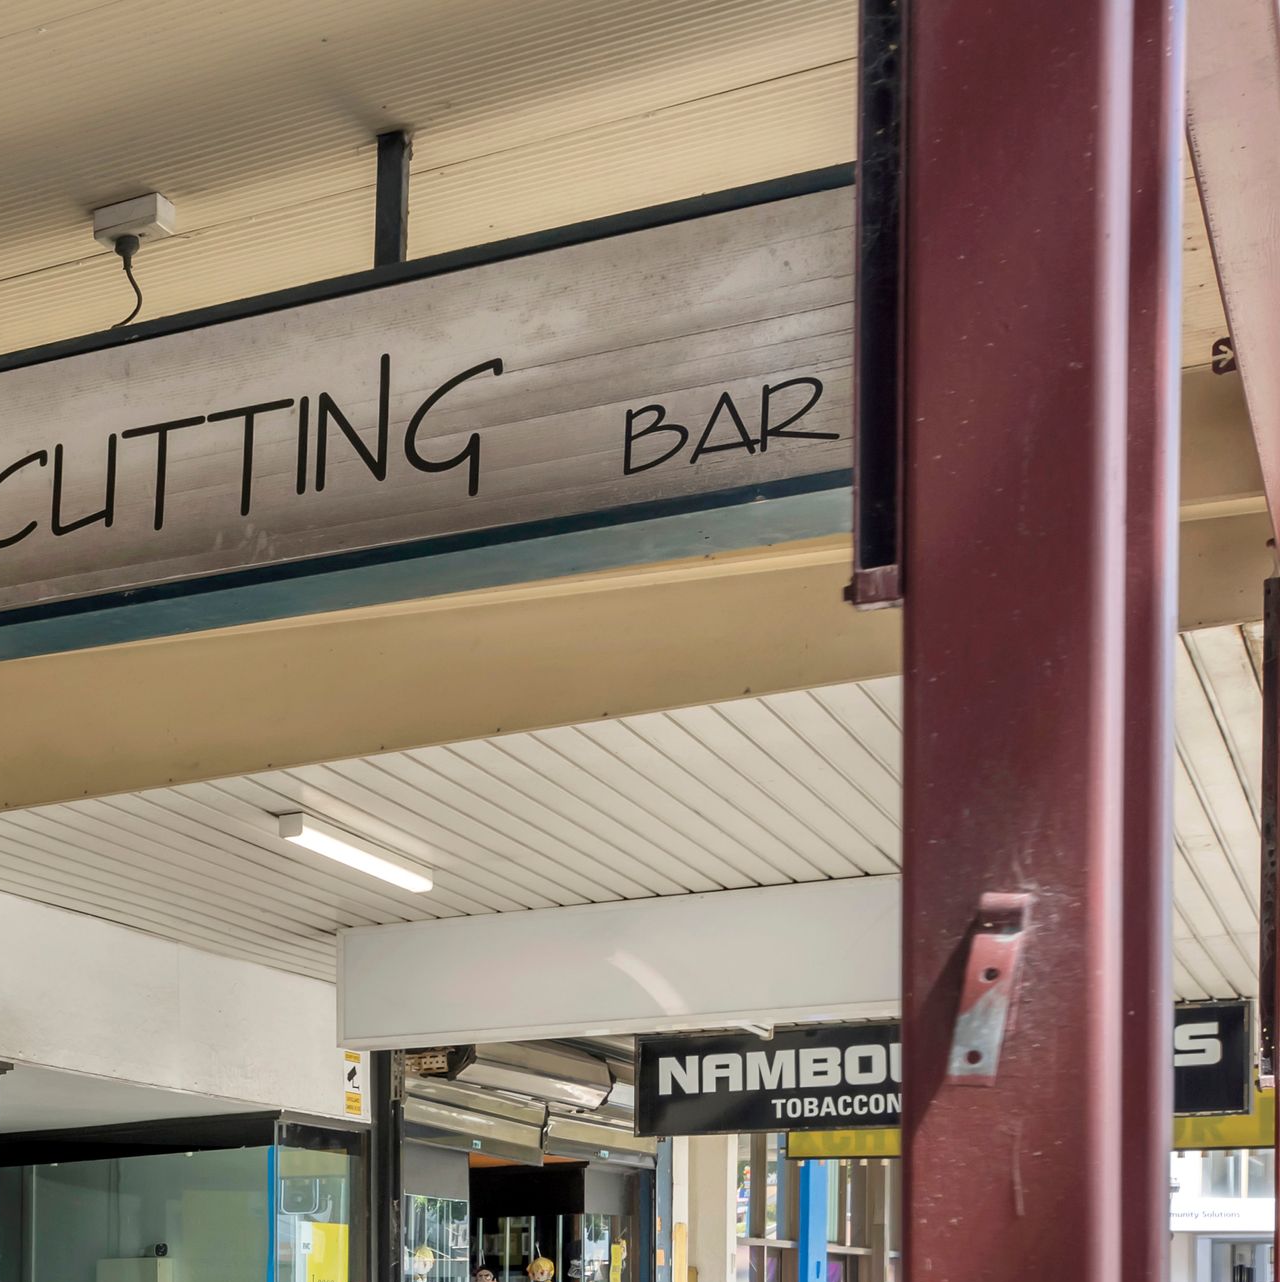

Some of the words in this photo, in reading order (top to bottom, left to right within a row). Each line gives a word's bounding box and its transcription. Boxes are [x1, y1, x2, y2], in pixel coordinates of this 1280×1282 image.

[624, 377, 840, 475] BAR
[771, 1093, 902, 1119] TOBACCON
[1202, 1210, 1241, 1218] Solutions
